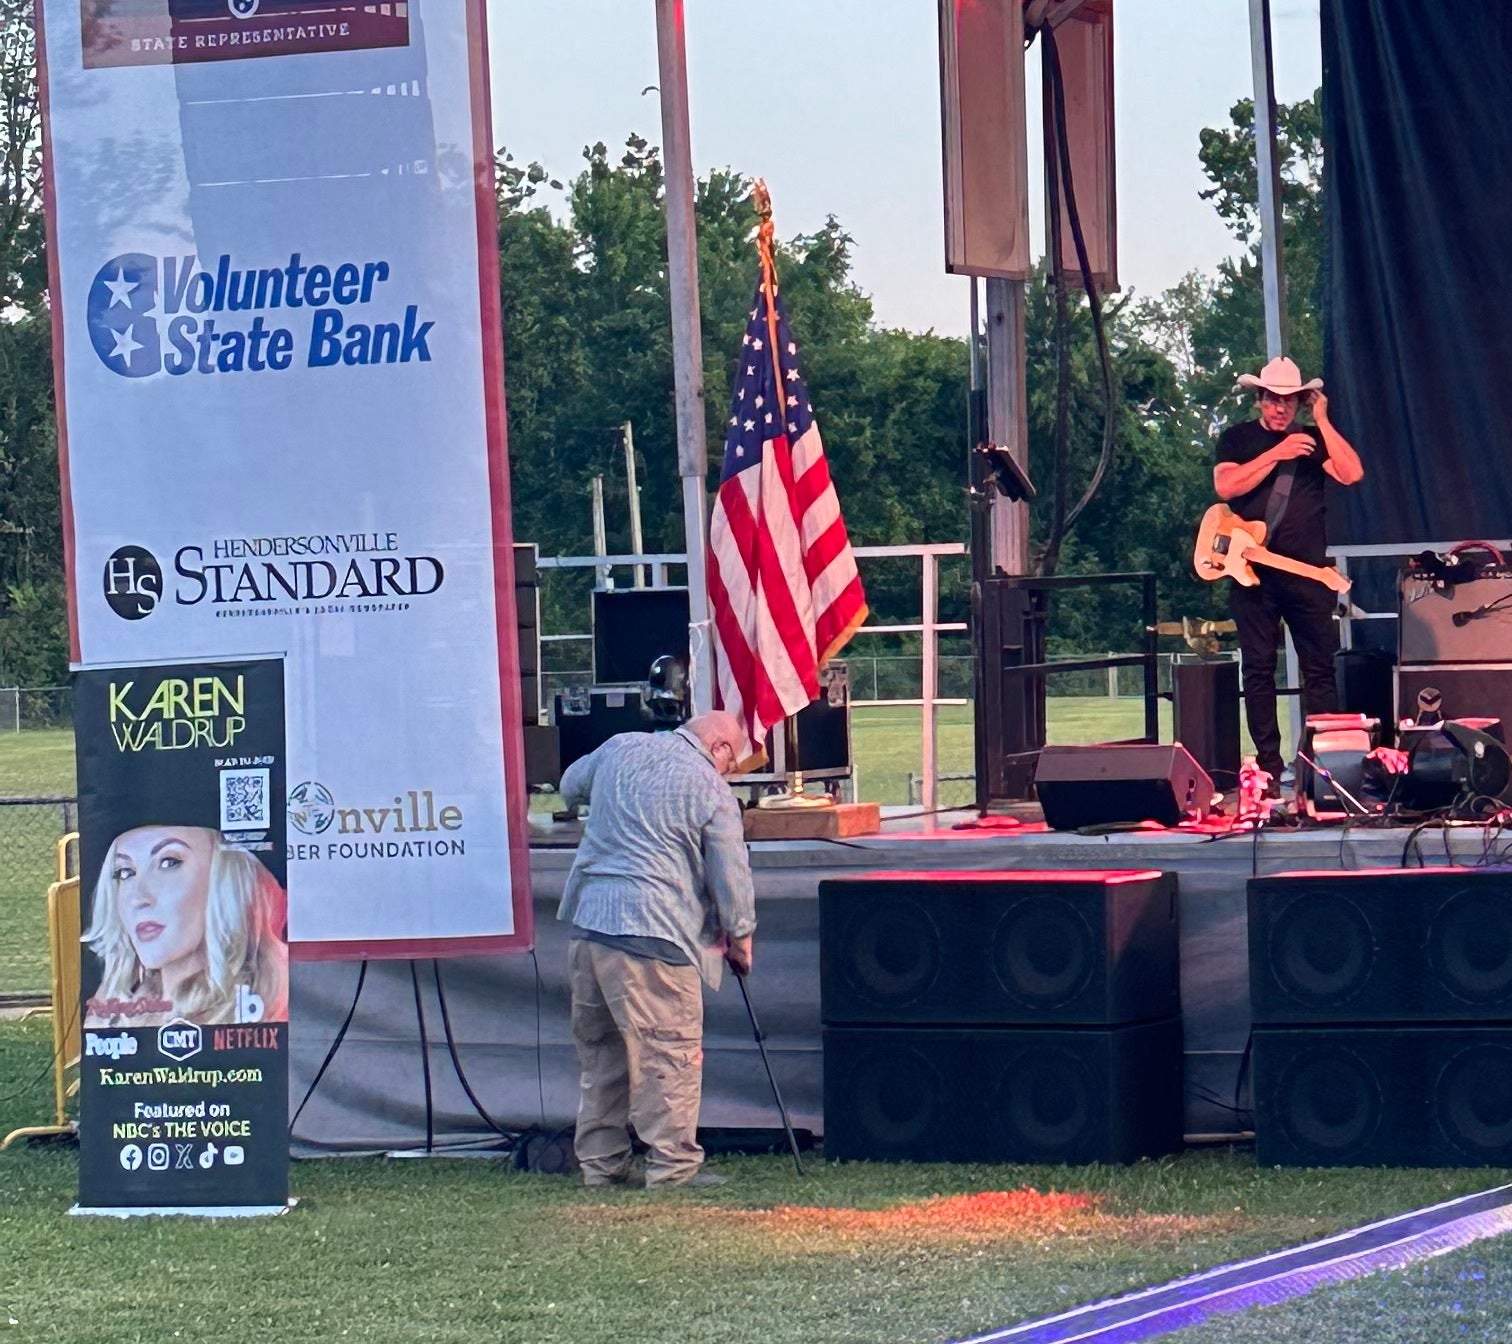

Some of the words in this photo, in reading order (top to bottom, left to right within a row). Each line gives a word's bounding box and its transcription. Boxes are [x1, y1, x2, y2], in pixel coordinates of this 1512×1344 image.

[131, 36, 188, 52] STATE
[195, 22, 350, 48] REPRESENTATIVE
[162, 253, 390, 314] Volunteer
[163, 315, 294, 376] State
[307, 304, 436, 368] Bank
[213, 532, 398, 559] HENDERSONVILLE
[174, 545, 444, 606] STANDARD
[109, 674, 245, 722] KAREN
[111, 716, 246, 752] WALDRUP
[328, 839, 465, 860] FOUNDATION
[162, 1030, 198, 1049] CMT
[213, 1028, 279, 1050] NETFLIX
[100, 1067, 263, 1087] KarenWaldrup.com
[134, 1101, 205, 1119] Featured
[209, 1104, 230, 1117] on
[164, 1121, 197, 1137] THE
[200, 1120, 251, 1136] VOICE
